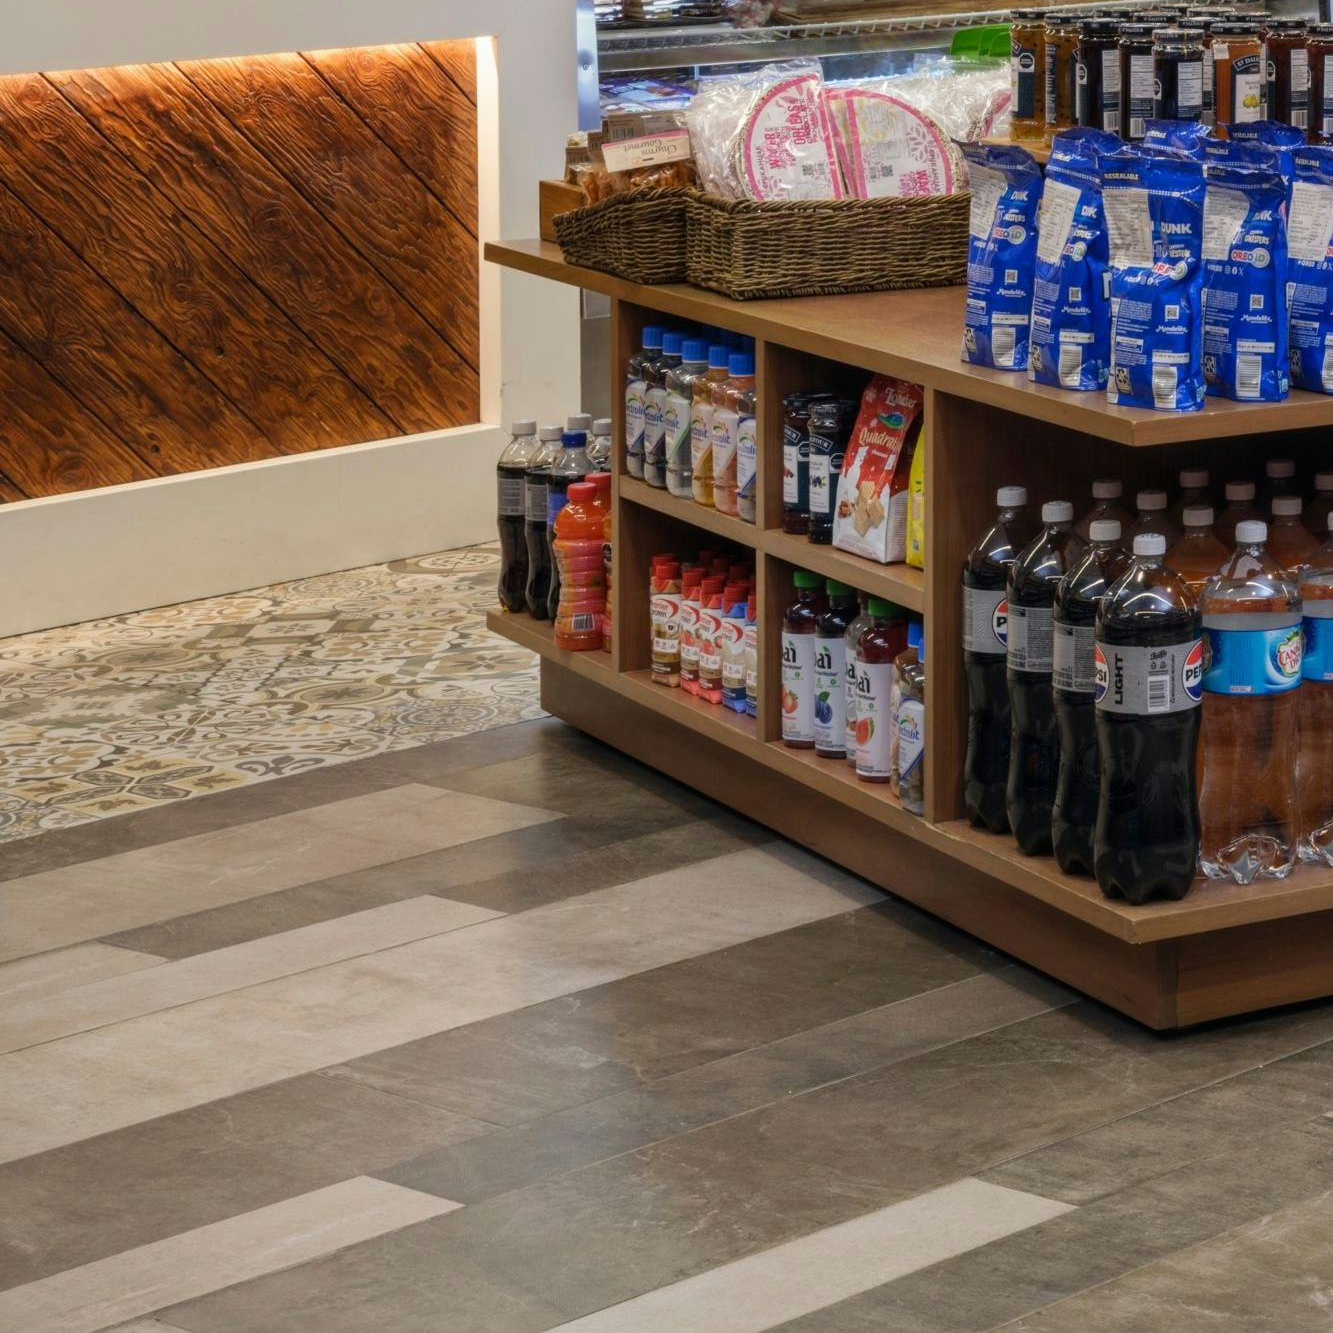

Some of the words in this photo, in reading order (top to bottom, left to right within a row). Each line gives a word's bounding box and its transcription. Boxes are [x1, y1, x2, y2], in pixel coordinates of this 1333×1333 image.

[1161, 222, 1192, 234] DUNK
[1231, 250, 1253, 261] OREO
[1115, 654, 1123, 705] LIGHT
